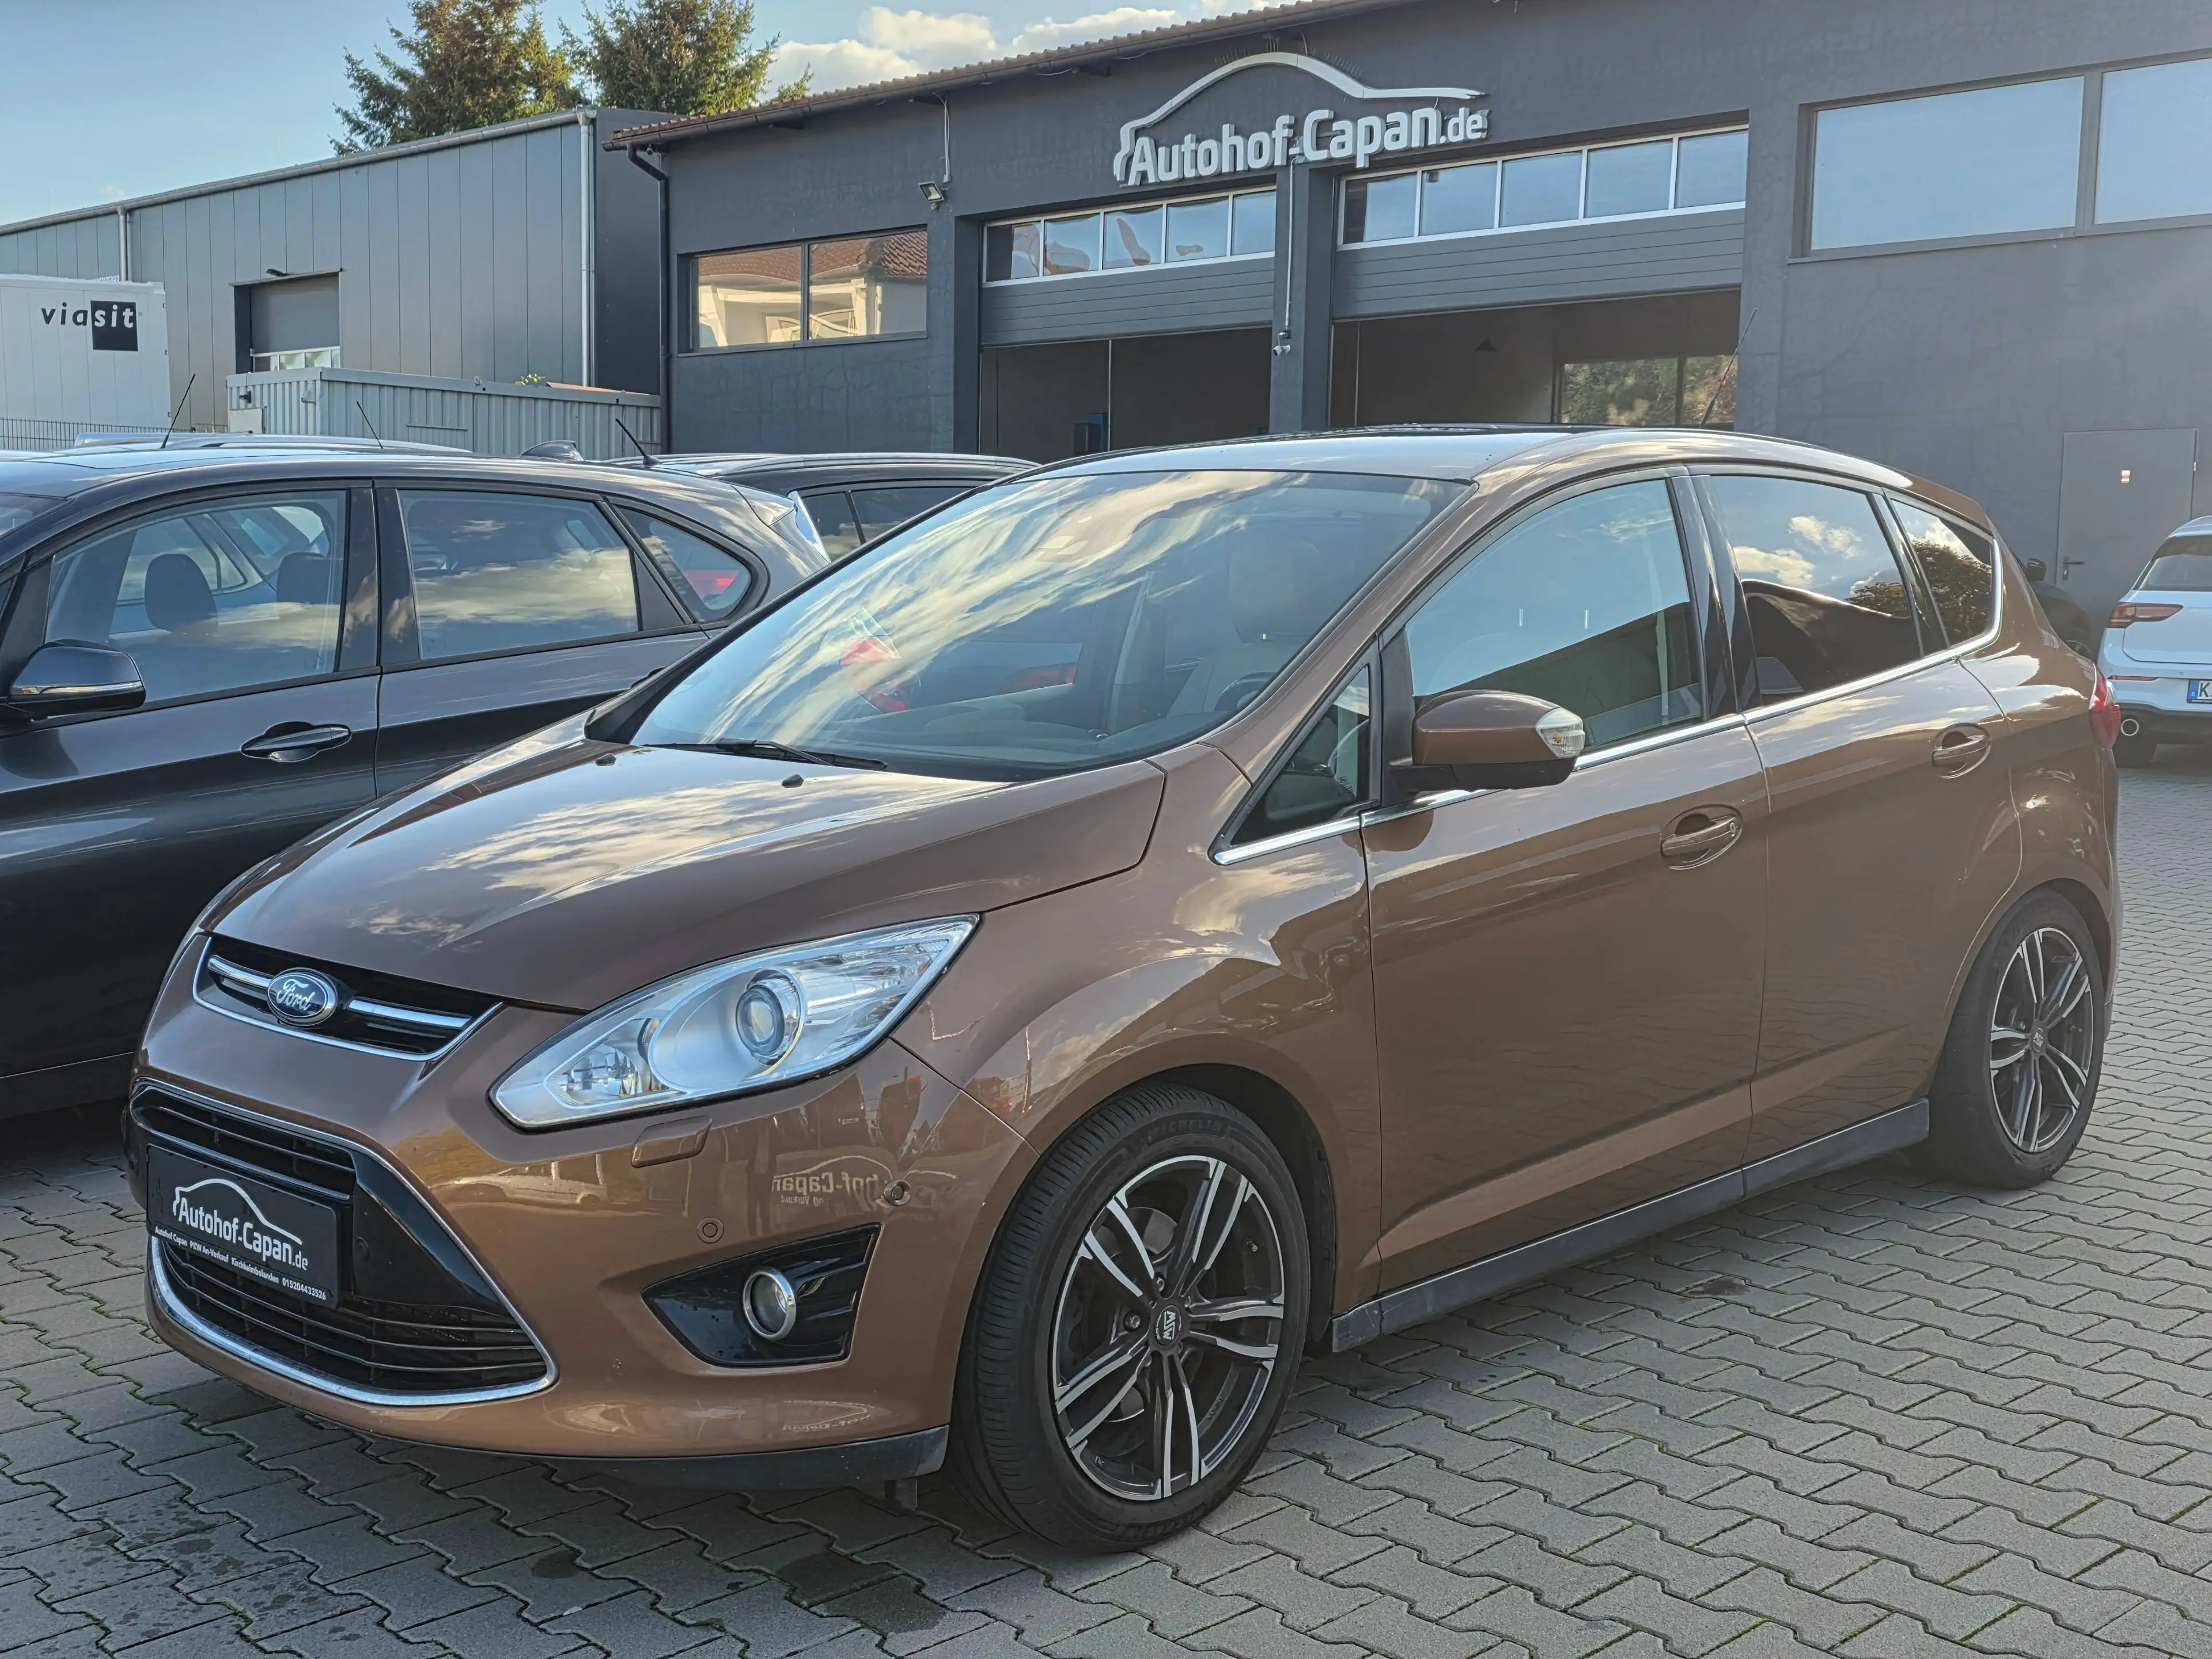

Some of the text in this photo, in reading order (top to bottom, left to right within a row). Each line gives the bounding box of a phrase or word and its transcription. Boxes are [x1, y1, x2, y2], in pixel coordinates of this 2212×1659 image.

[1128, 107, 1487, 187] Autohof-Capan.de
[41, 302, 134, 328] viasit
[2199, 683, 2212, 698] K
[276, 978, 316, 1011] Ford
[178, 1197, 309, 1271] Autohof-Capan.de
[155, 1226, 327, 1301] Autohof Capan PKW An-Verkauf Kirchheimbolanden 015204433526
